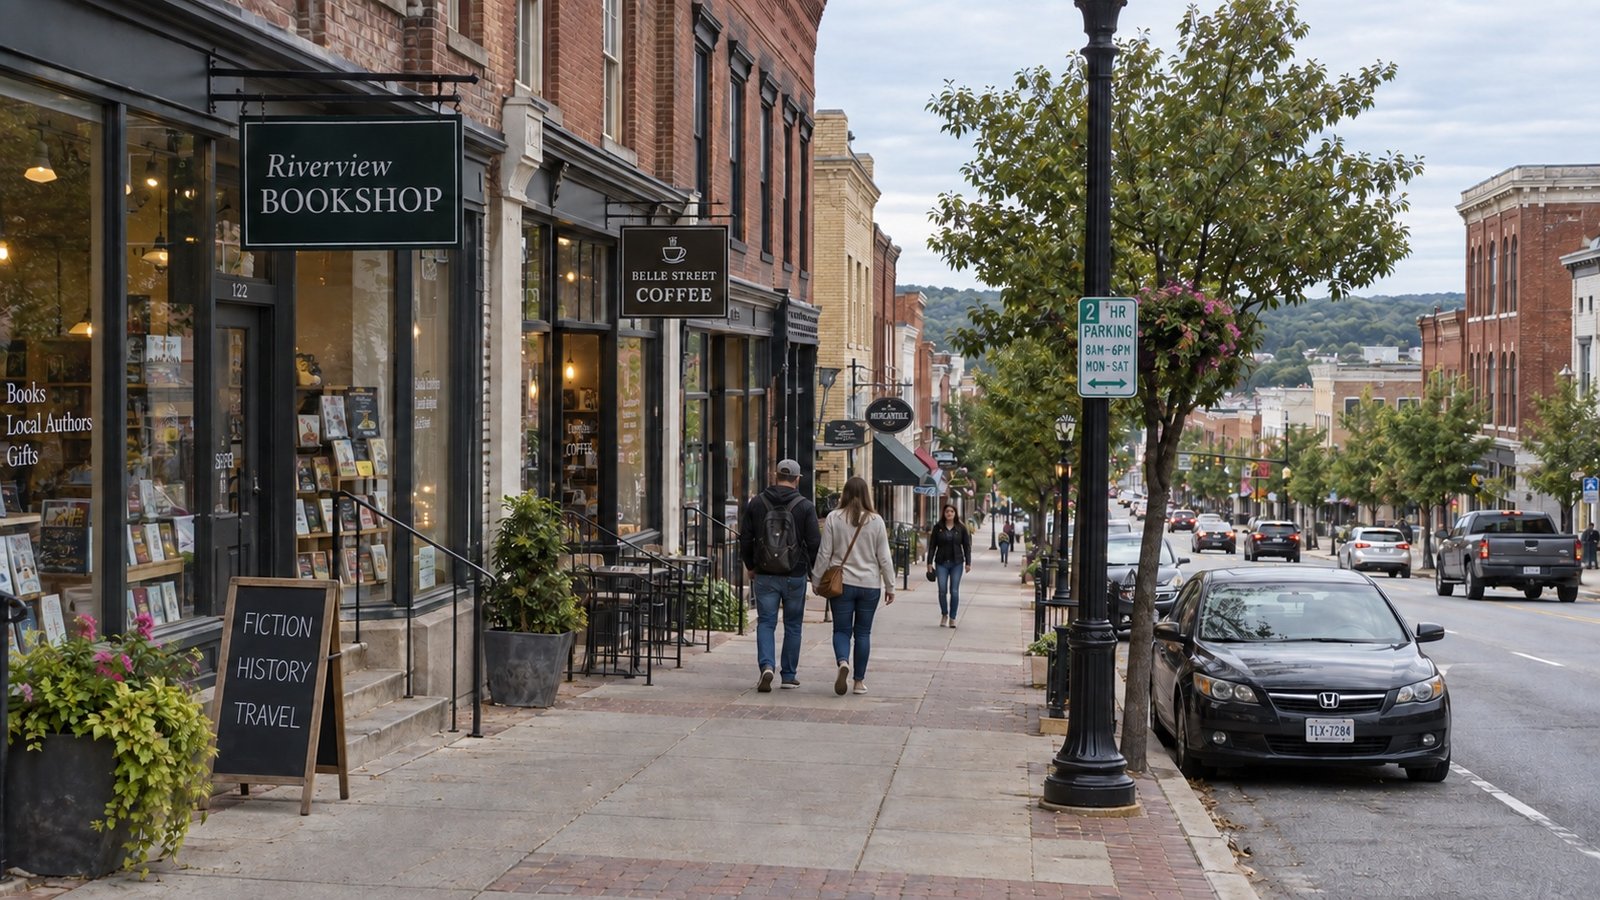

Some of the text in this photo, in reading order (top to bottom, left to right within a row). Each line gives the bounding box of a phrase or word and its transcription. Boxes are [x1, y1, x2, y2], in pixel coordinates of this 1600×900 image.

[265, 152, 393, 179] Riverview
[260, 186, 443, 215] BOOKSHOP
[632, 271, 717, 281] BELLE STREET
[232, 283, 248, 298] 122
[636, 287, 712, 303] COFFEE
[1086, 303, 1125, 320] 2 HR
[1084, 325, 1131, 337] PARKING
[6, 381, 46, 404] Books
[6, 411, 93, 436] Local Authors
[870, 412, 908, 420] MERCANTILE
[6, 443, 39, 467] Gifts
[243, 612, 313, 638] FICTION
[236, 656, 312, 683] HISTORY
[234, 701, 301, 729] TRAVEL
